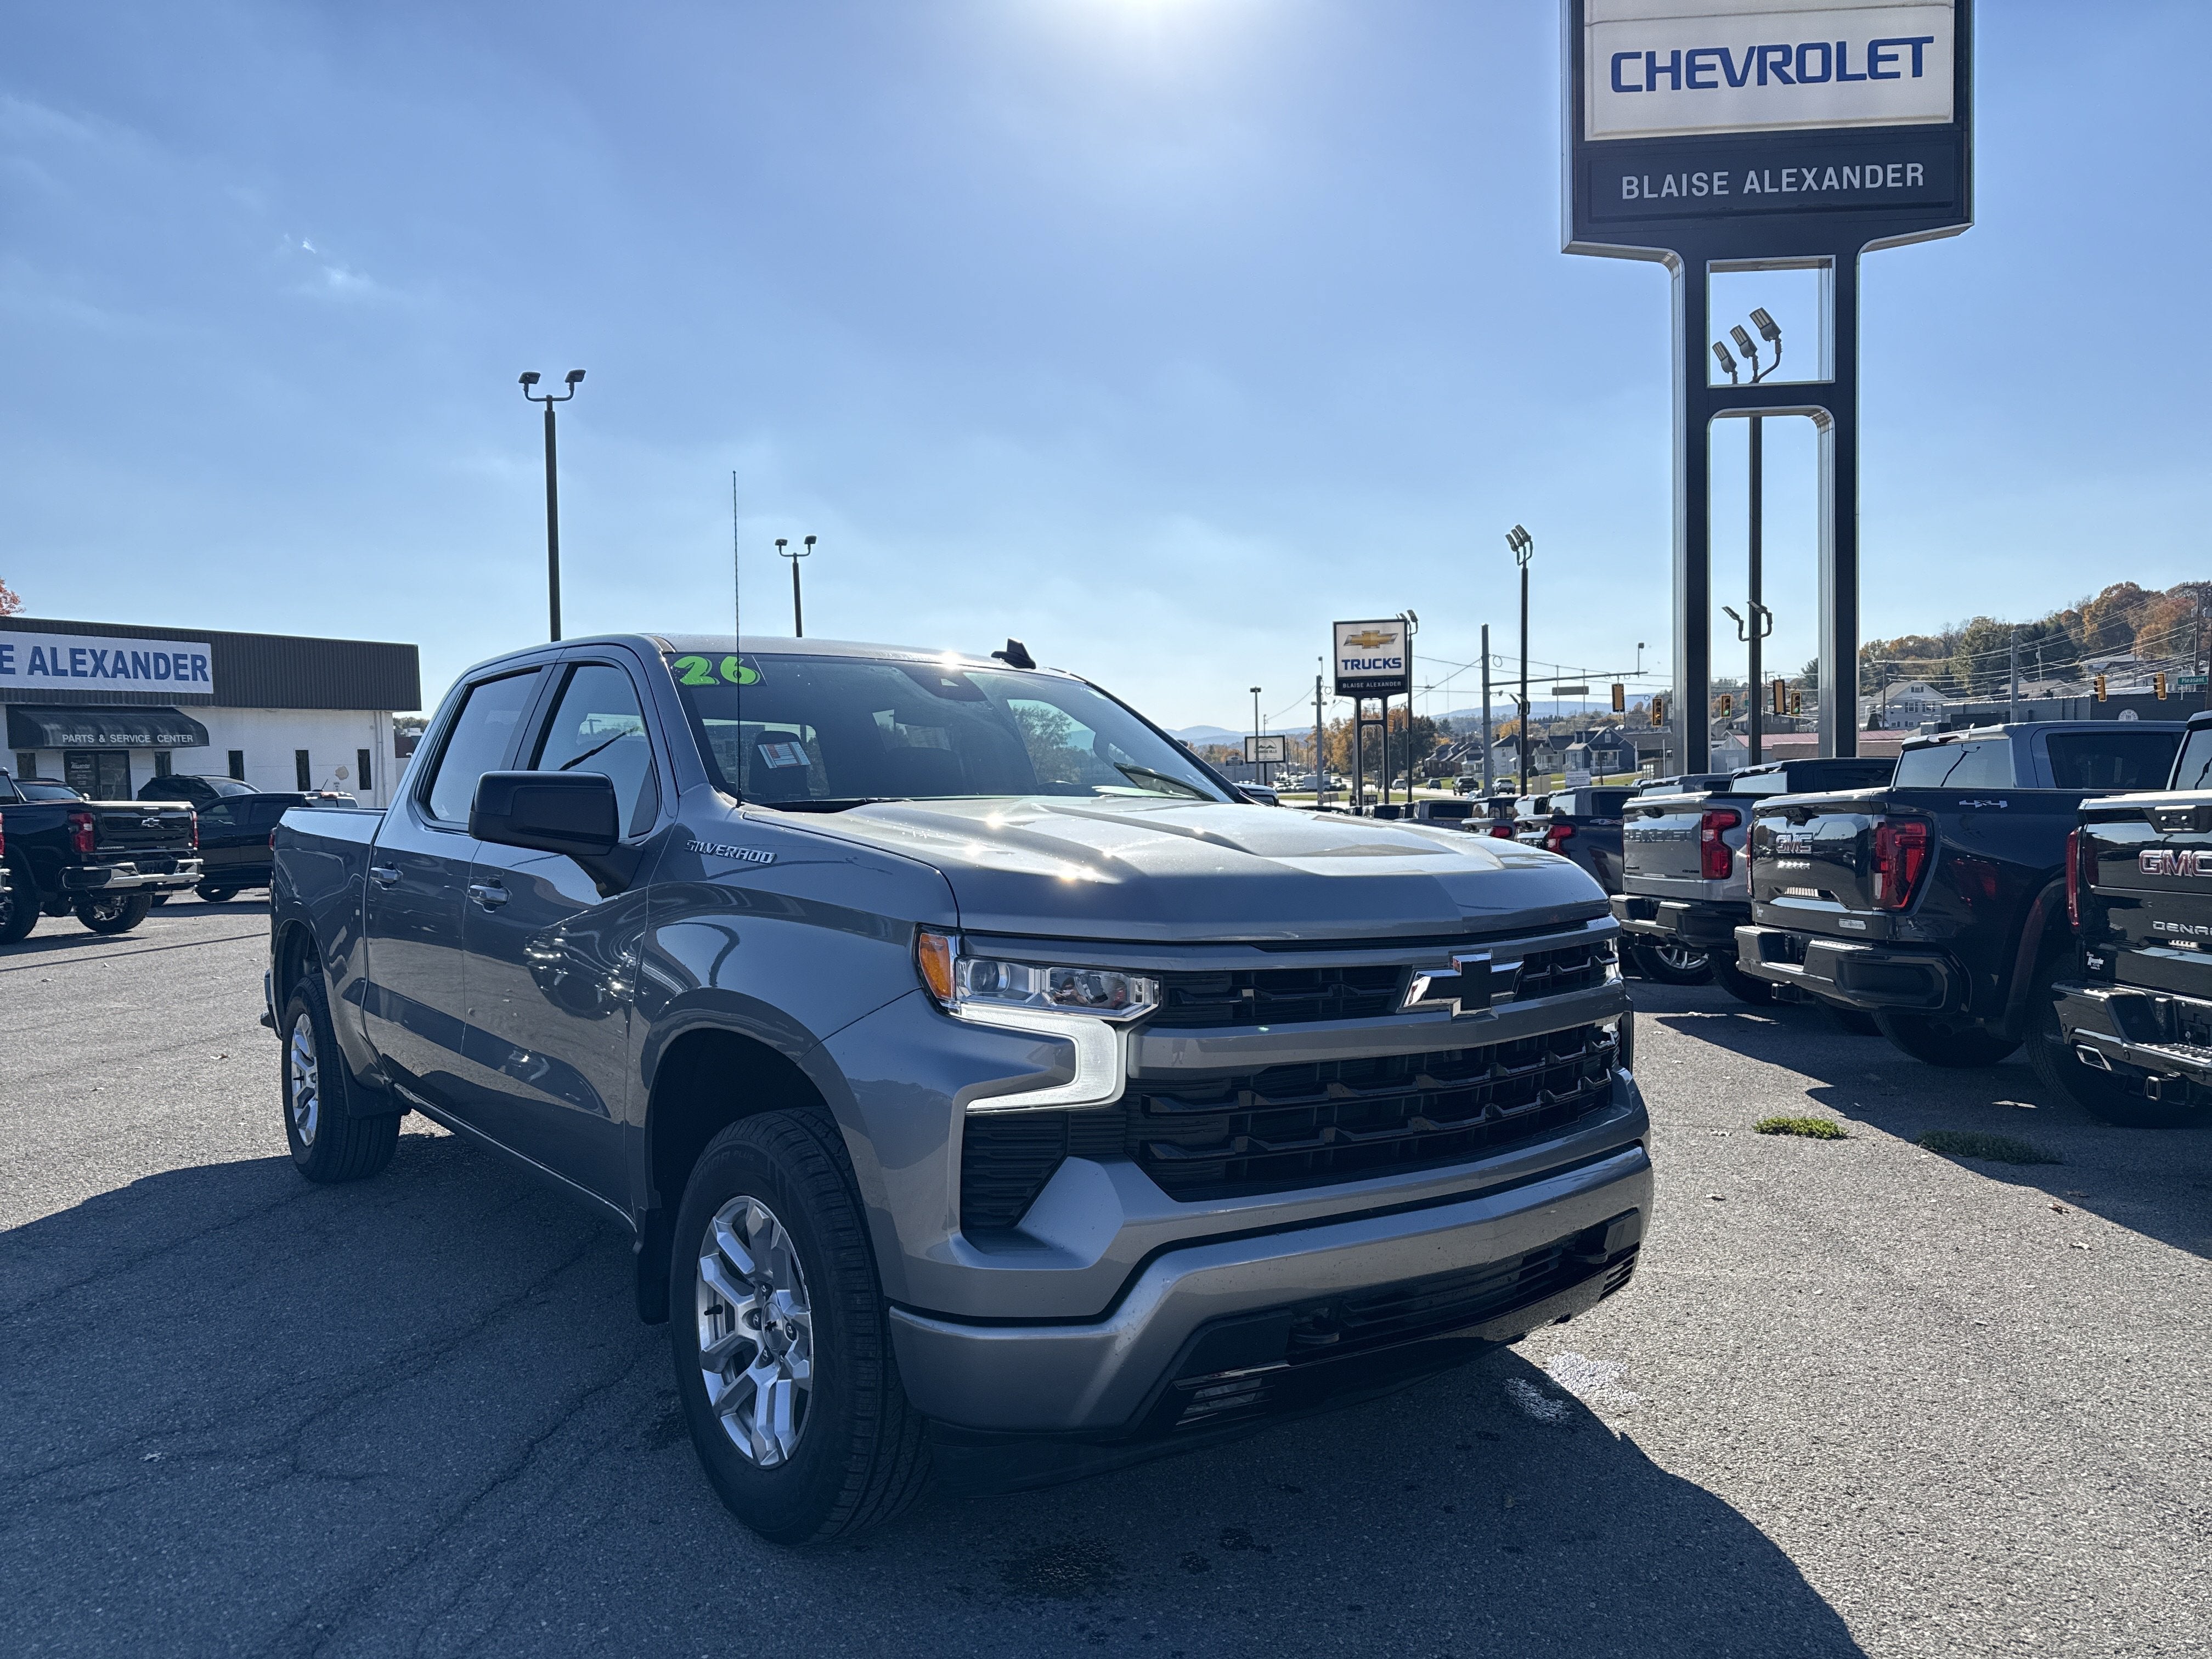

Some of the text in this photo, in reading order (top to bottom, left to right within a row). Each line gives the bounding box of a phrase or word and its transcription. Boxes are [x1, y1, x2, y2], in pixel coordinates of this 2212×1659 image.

[1611, 36, 1934, 93] CHEVROLET
[1621, 162, 1925, 200] BLAISE ALEXANDER
[27, 646, 210, 682] ALEXANDER
[673, 656, 760, 686] 26
[1341, 657, 1402, 670] TRUCKS
[62, 734, 194, 743] PARTS & SERVICE CENTER
[686, 839, 777, 864] SILVERADO
[1776, 833, 1812, 854] GMC
[2139, 849, 2212, 877] GMC
[733, 1150, 755, 1161] PLUS
